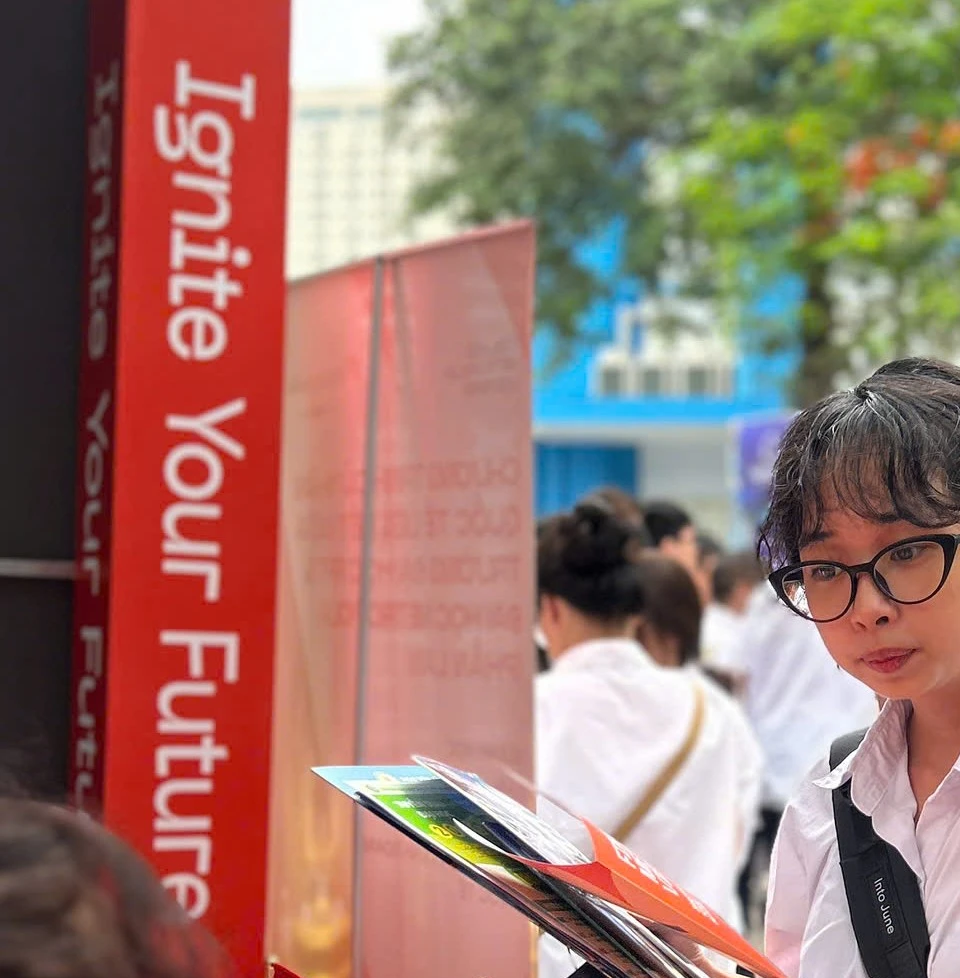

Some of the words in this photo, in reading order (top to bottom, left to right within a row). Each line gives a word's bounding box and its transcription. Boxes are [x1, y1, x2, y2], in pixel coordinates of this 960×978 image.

[154, 61, 256, 362] Ignite
[81, 389, 110, 597] Your
[160, 397, 246, 602] Your
[152, 629, 239, 922] Future
[874, 877, 886, 902] Into
[880, 904, 894, 934] June
